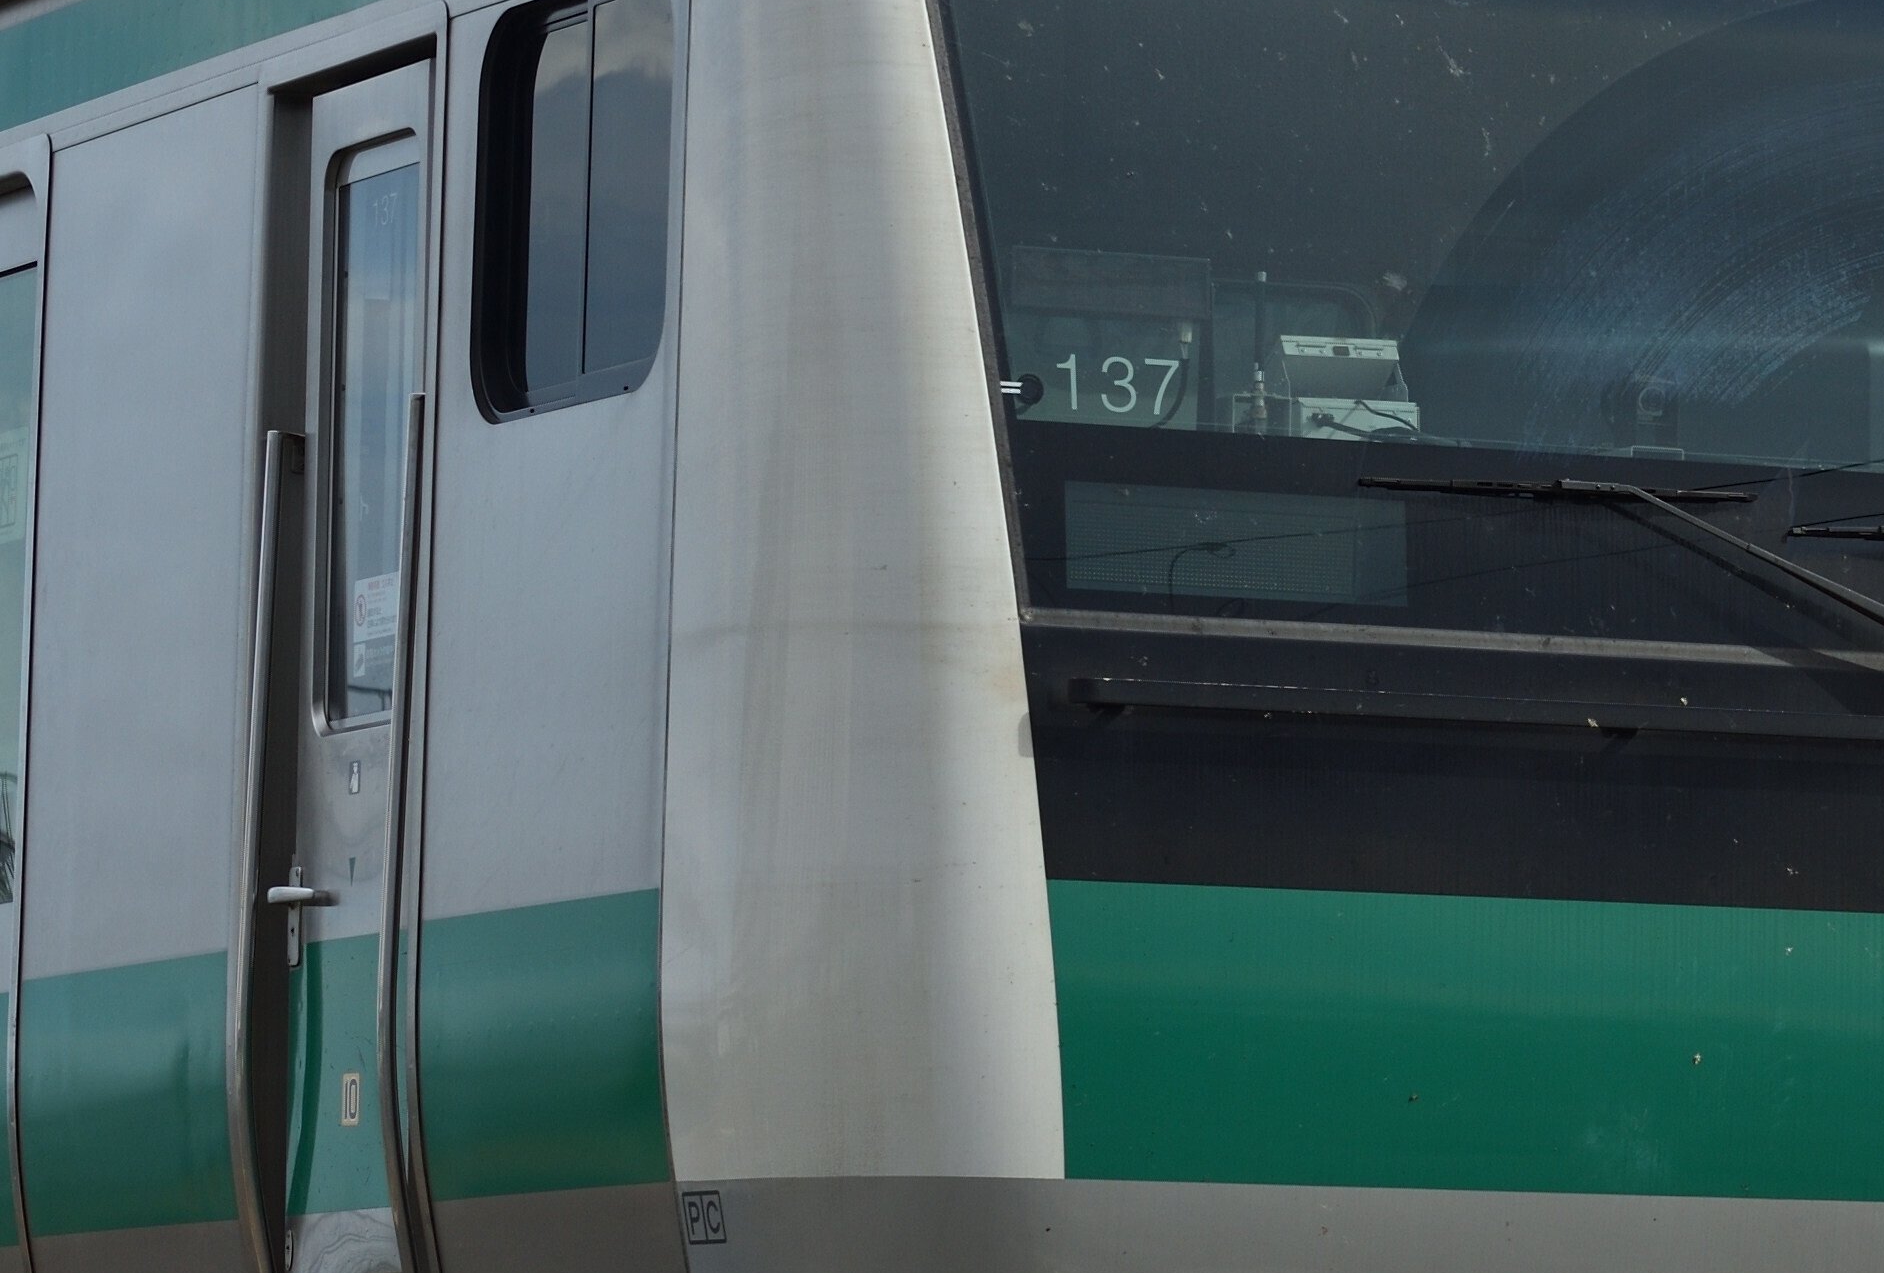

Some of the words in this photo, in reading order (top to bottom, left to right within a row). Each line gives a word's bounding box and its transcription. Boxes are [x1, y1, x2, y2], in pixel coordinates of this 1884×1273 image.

[372, 192, 398, 226] 137
[1055, 351, 1180, 415] 137
[344, 1077, 359, 1120] 10
